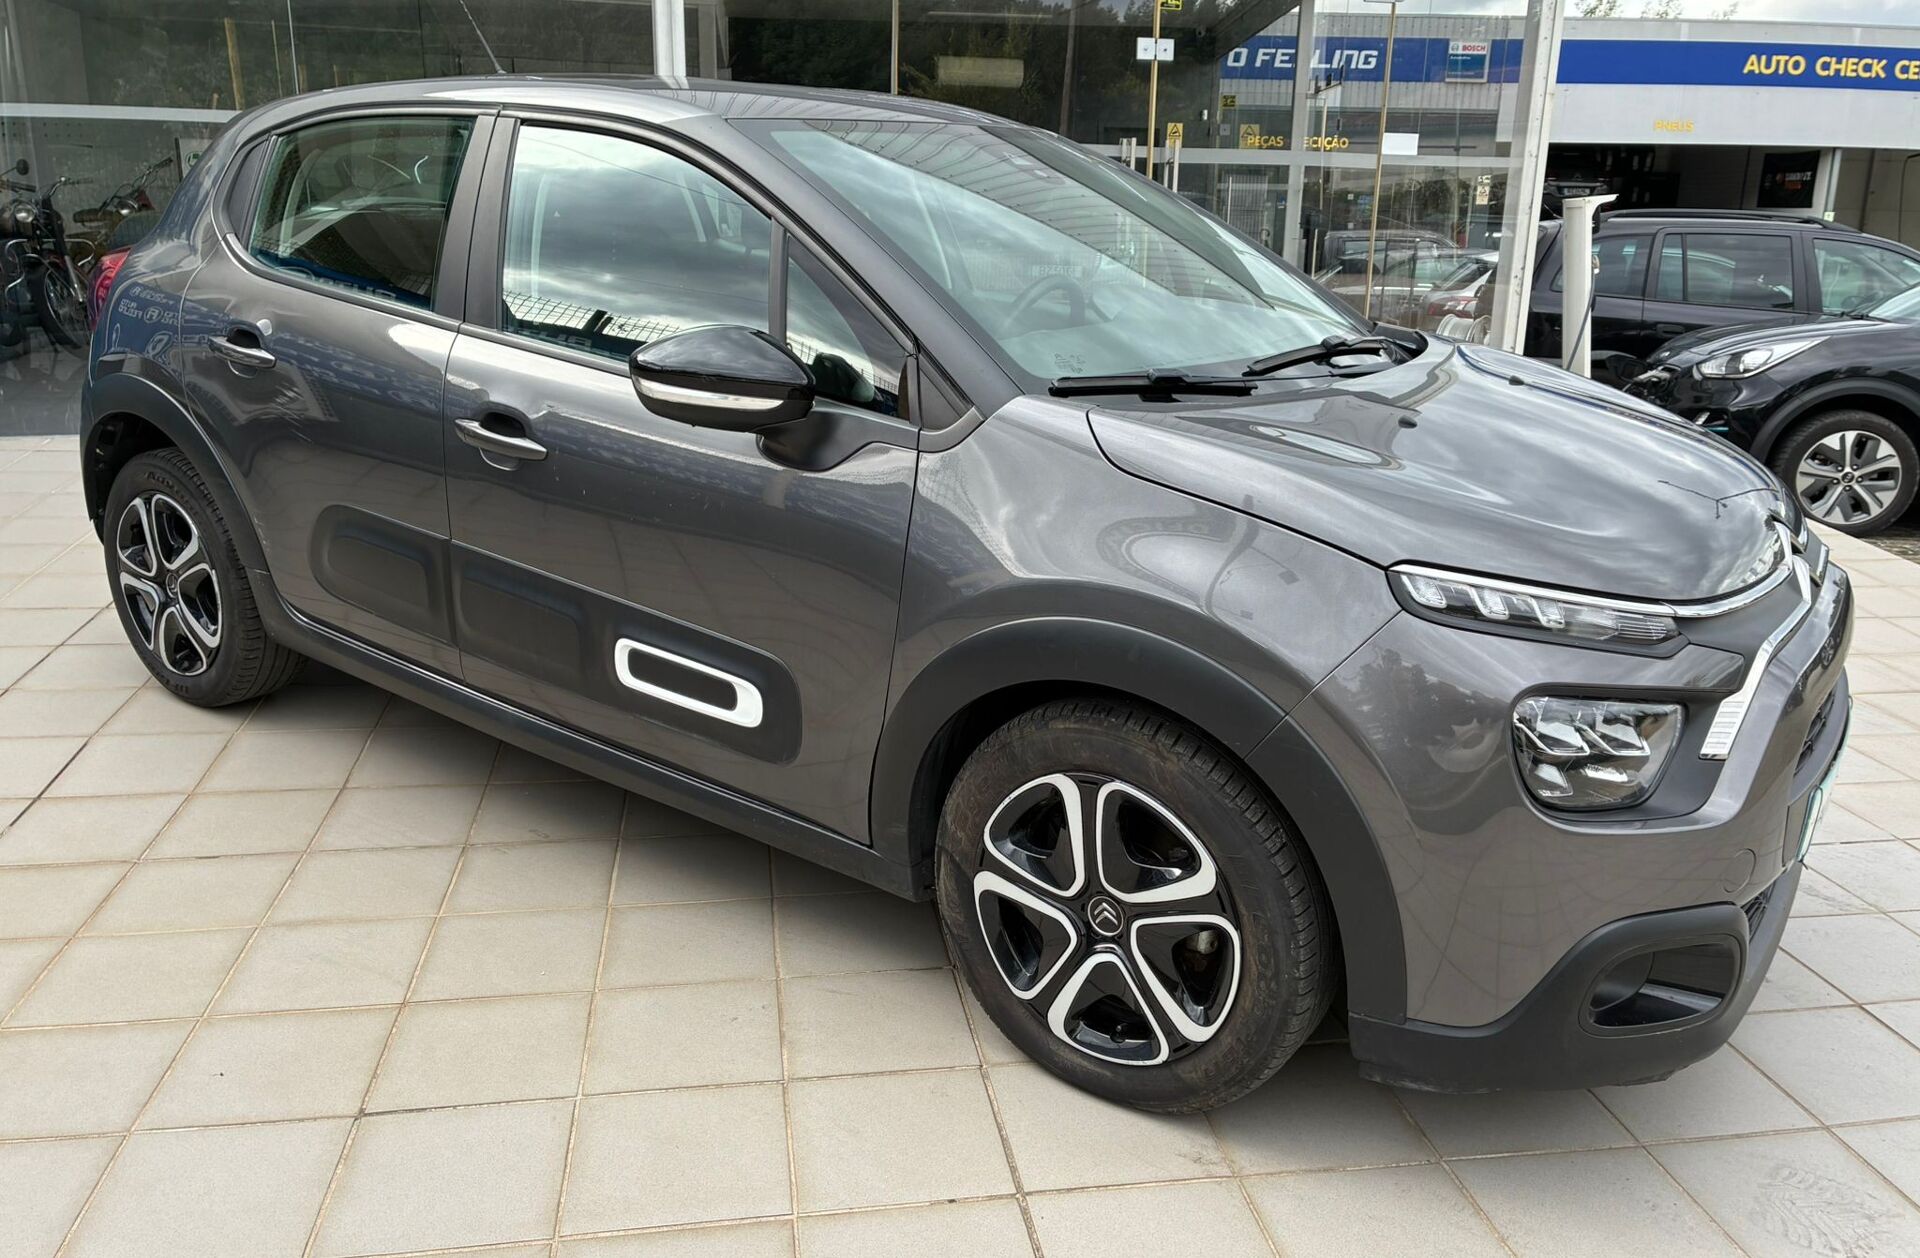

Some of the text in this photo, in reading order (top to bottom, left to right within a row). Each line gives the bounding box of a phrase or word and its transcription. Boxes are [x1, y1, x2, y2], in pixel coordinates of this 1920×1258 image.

[1255, 48, 1378, 69] FELING
[1743, 54, 1806, 75] AUTO
[1815, 56, 1887, 79] CHECK
[1653, 119, 1695, 132] PNEUS
[1247, 135, 1284, 148] PEÇAS
